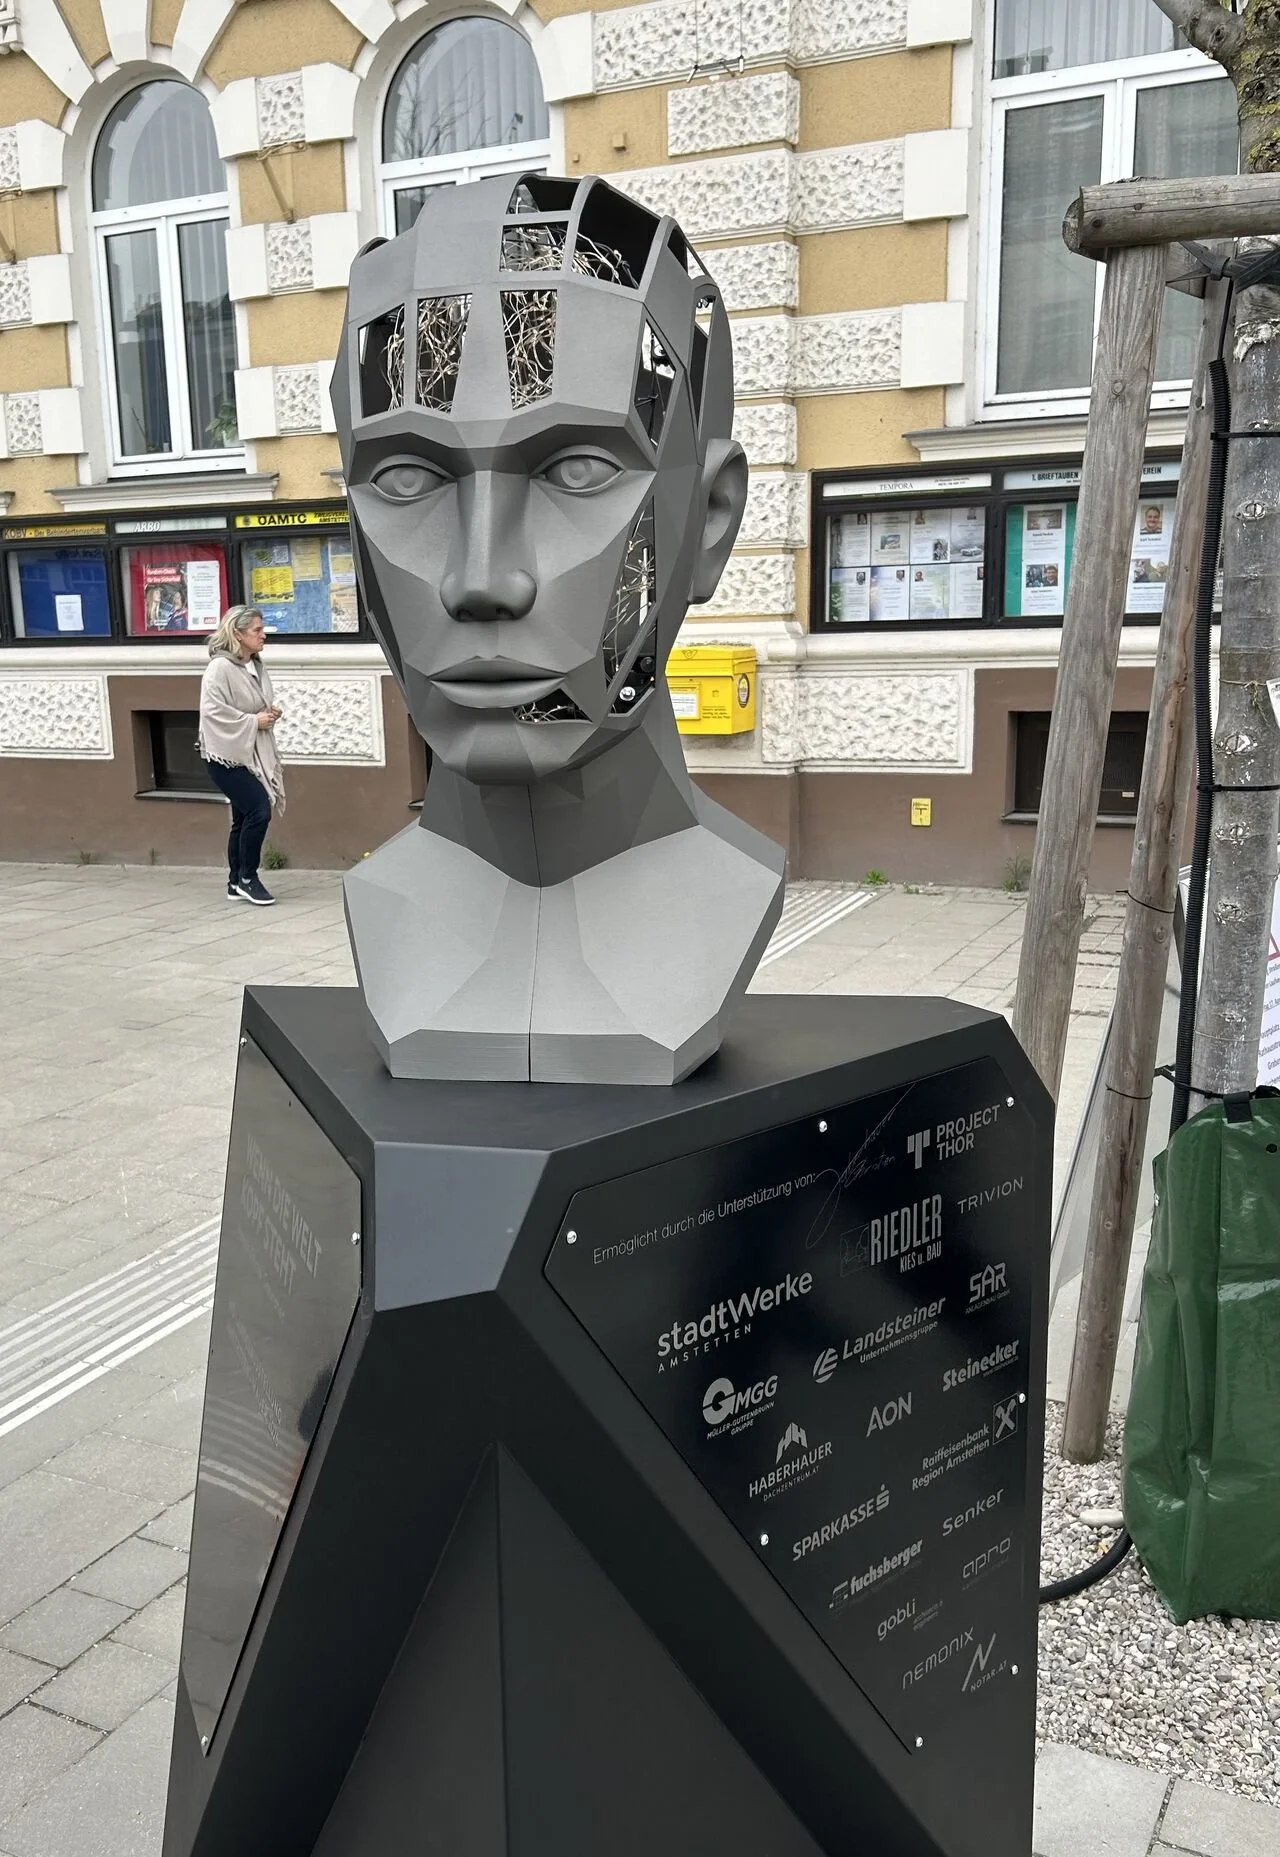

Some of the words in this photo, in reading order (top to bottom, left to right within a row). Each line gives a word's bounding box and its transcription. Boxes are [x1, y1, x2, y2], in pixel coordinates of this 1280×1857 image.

[879, 482, 914, 491] TEMPORA
[1143, 466, 1162, 476] EREIN
[936, 1104, 1000, 1142] PROJECT
[936, 1132, 975, 1161] THOR
[592, 1229, 658, 1265] Ermöglicht
[661, 1216, 694, 1239] durch
[697, 1208, 715, 1225] die
[717, 1181, 792, 1218] Unterstützung
[794, 1173, 816, 1189] von:
[957, 1176, 1024, 1214] TRIVION
[291, 1203, 323, 1280] WELT
[870, 1193, 942, 1266] RIEDLER
[263, 1215, 296, 1296] STEHT
[900, 1252, 916, 1273] KIES
[926, 1240, 942, 1262] BAU
[969, 1262, 1007, 1304] SAR
[657, 1272, 813, 1357] stadtWerke
[842, 1297, 946, 1360] Landsteiner
[657, 1323, 752, 1374] AMSTETTEN
[859, 1320, 938, 1364] Unternehmensgruppe
[942, 1339, 1020, 1392] Steinecker
[730, 1418, 755, 1436] GRUPPE
[865, 1391, 912, 1438] AON
[749, 1441, 833, 1498] HABERHAUER
[912, 1465, 944, 1491] Region
[946, 1439, 990, 1471] Amstetten
[922, 1422, 990, 1471] Raiffeisenbank
[763, 1465, 820, 1502] DACHZENTRUM.AT
[792, 1498, 875, 1562] SPARKASSE
[941, 1488, 1004, 1537] Senker
[850, 1539, 924, 1596] fuchsberger
[962, 1537, 1012, 1578] apro
[876, 1598, 916, 1642] gobli
